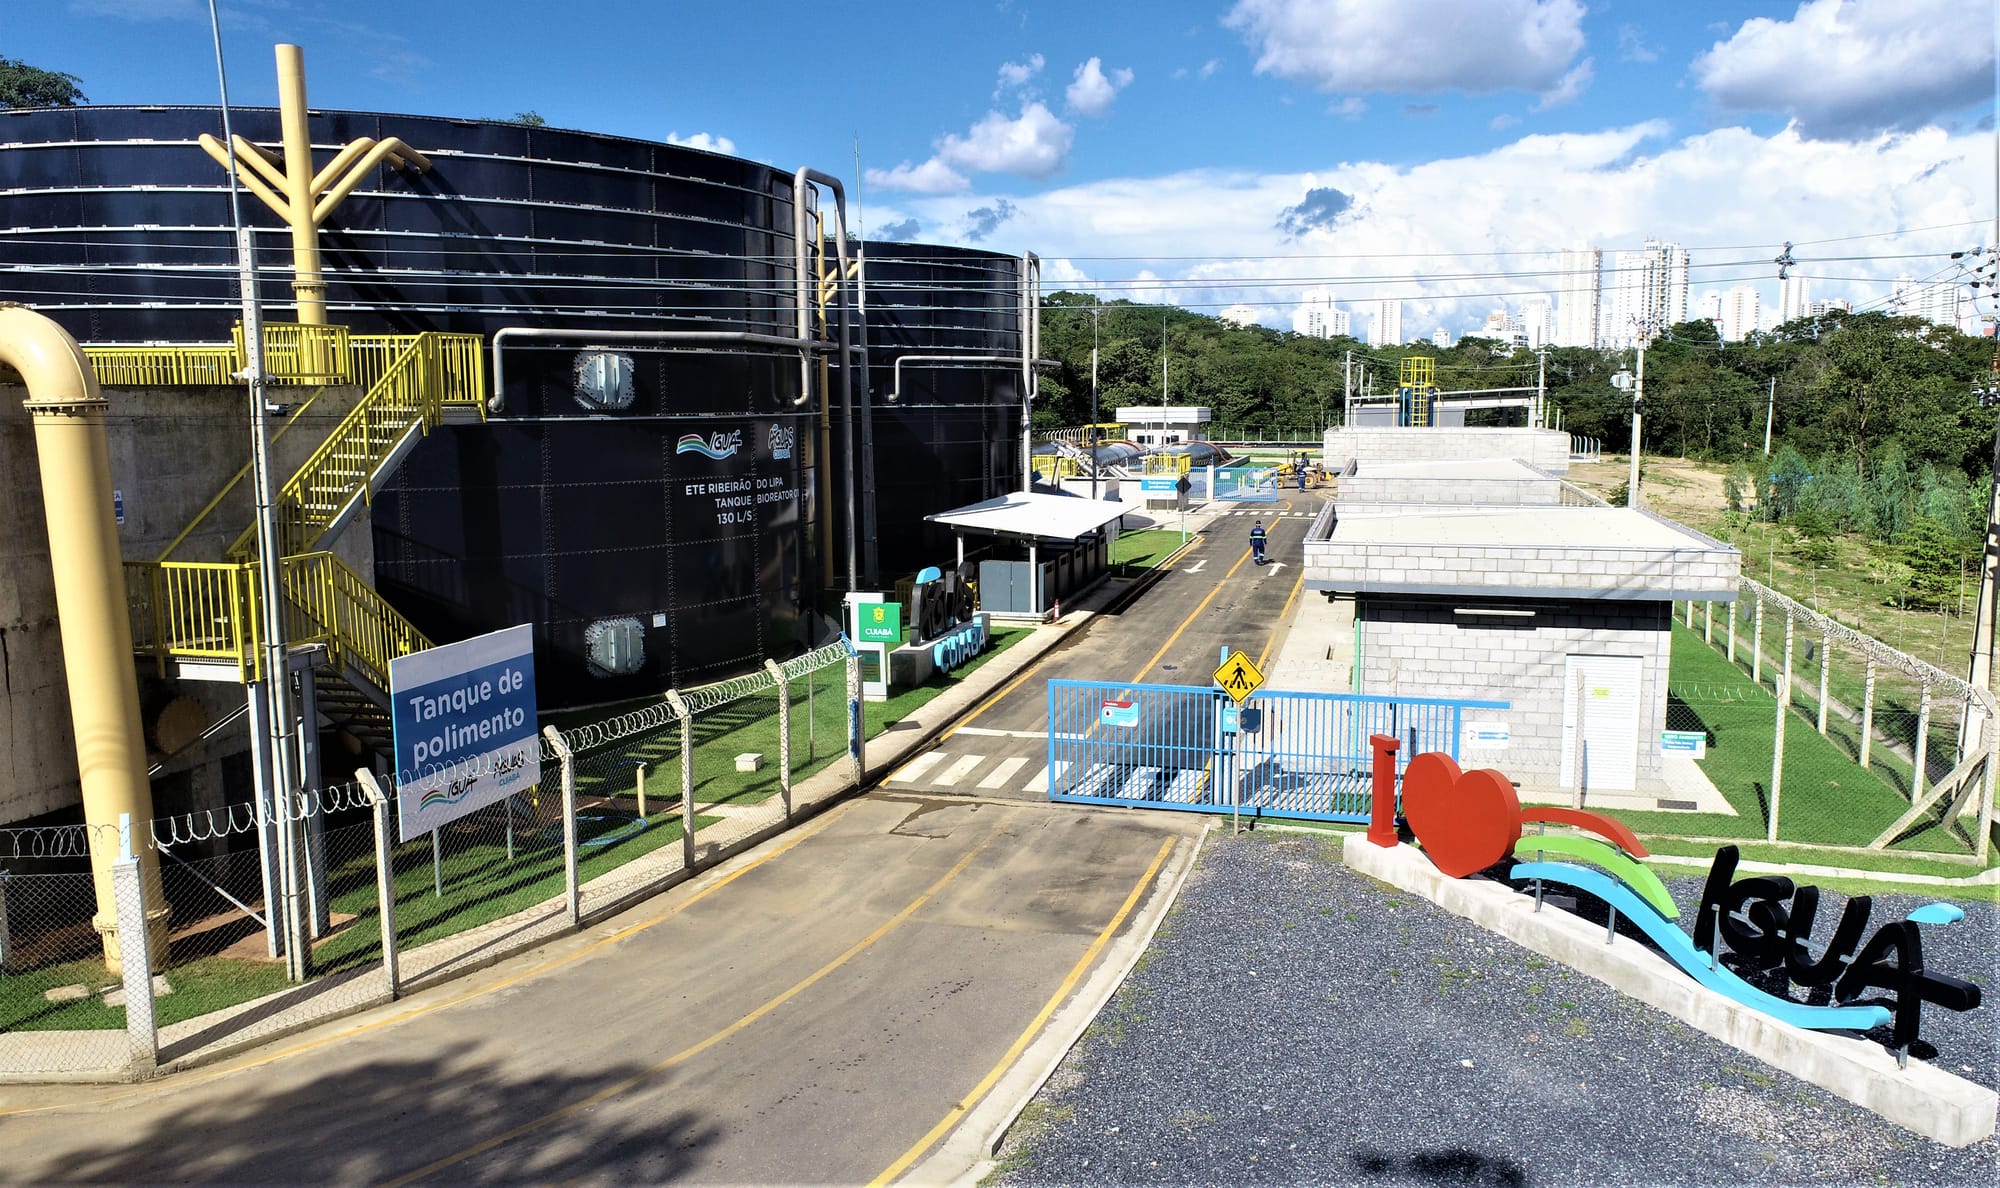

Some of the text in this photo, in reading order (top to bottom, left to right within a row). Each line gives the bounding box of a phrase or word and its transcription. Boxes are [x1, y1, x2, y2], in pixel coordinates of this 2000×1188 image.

[685, 477, 783, 495] ETE RIBEIRÃO DO LIPA
[715, 495, 751, 509] TANQUE
[757, 490, 793, 503] BIOREATOR
[717, 510, 752, 524] 130 L/S
[865, 627, 893, 636] CUIABÁ
[410, 668, 523, 723] Tanque de
[413, 706, 525, 769] polimento
